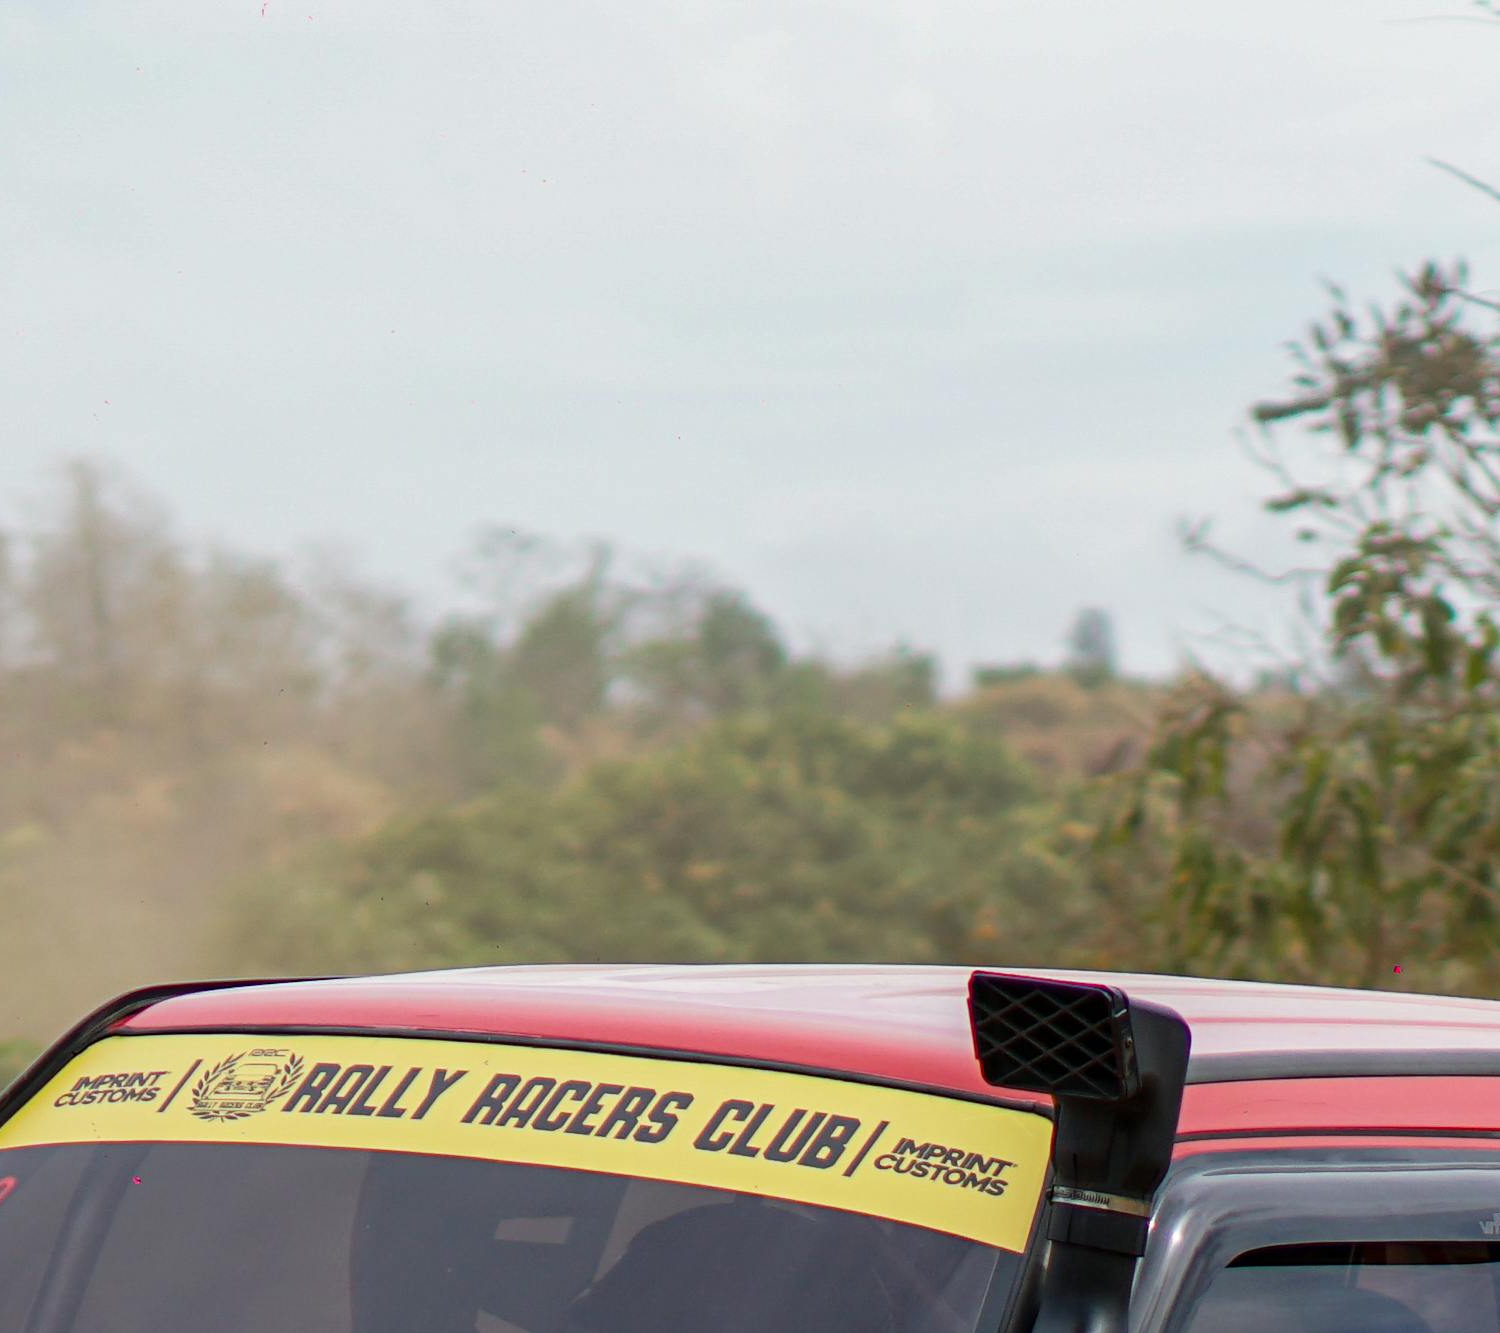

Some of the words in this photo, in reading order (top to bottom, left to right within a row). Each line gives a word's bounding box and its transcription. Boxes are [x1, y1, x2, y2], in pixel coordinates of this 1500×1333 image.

[54, 1086, 161, 1107] CUSTOMS
[71, 1071, 170, 1091] IMPRINT
[281, 1062, 469, 1120] RALLY
[460, 1073, 694, 1144] RACERS
[693, 1098, 860, 1169] CLUB
[873, 1153, 1009, 1196] CUSTOMS
[891, 1137, 1015, 1177] IMPRINT
